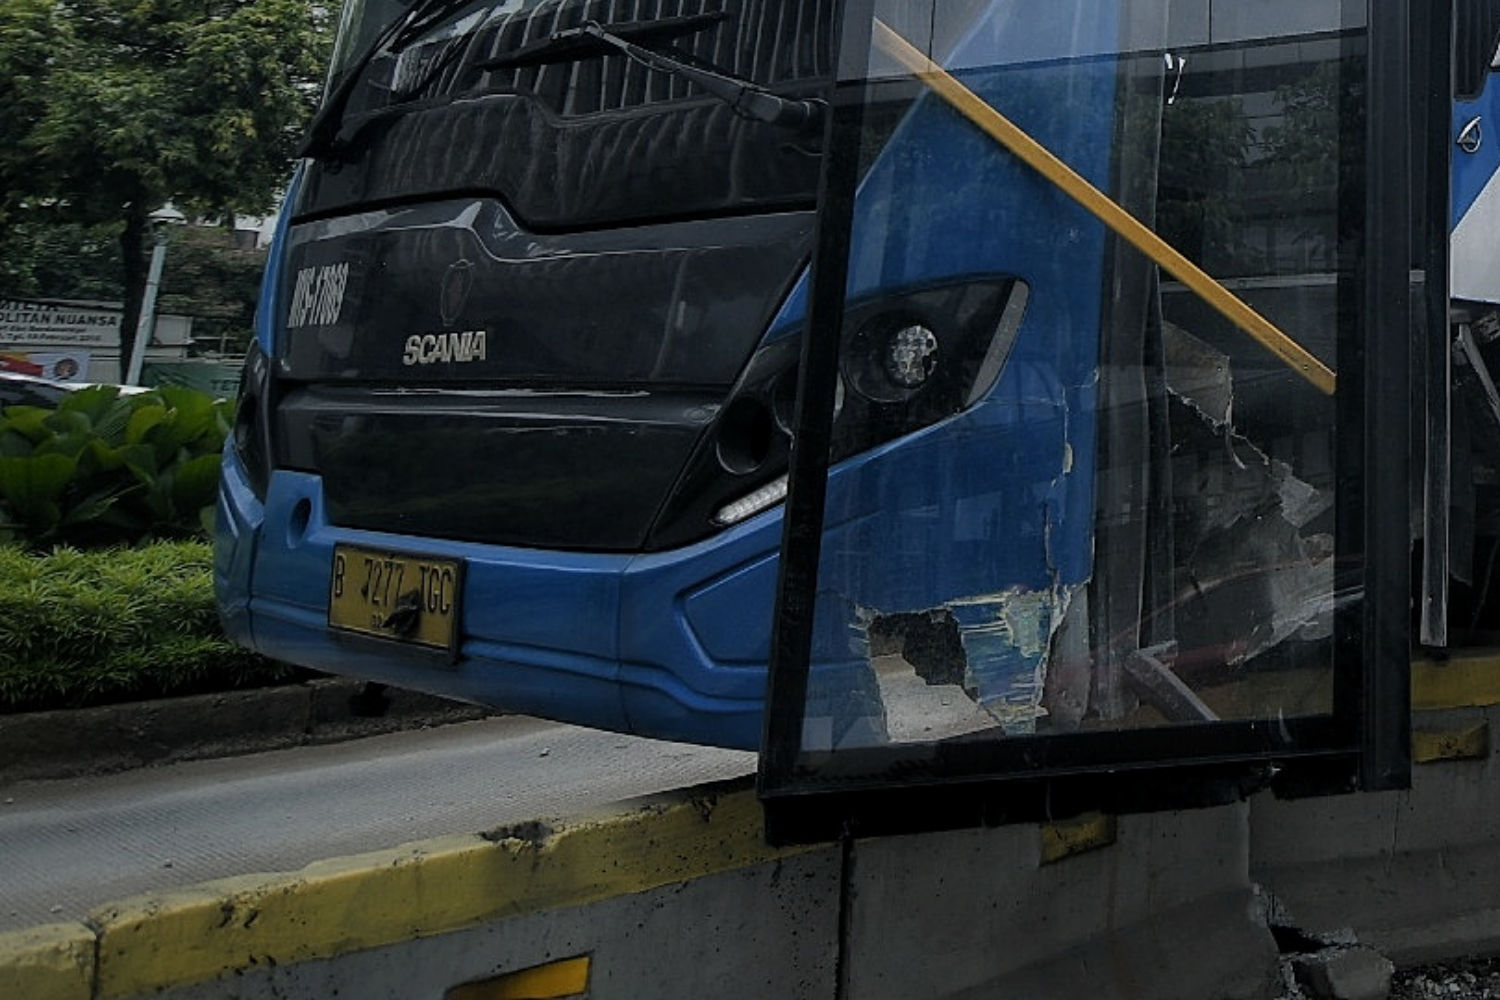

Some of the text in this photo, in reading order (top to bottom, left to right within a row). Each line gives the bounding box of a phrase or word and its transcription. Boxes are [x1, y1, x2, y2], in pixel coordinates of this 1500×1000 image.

[55, 313, 117, 326] NUANSA
[402, 331, 487, 365] SCANIA
[334, 554, 346, 598] B
[419, 562, 453, 615] TGC
